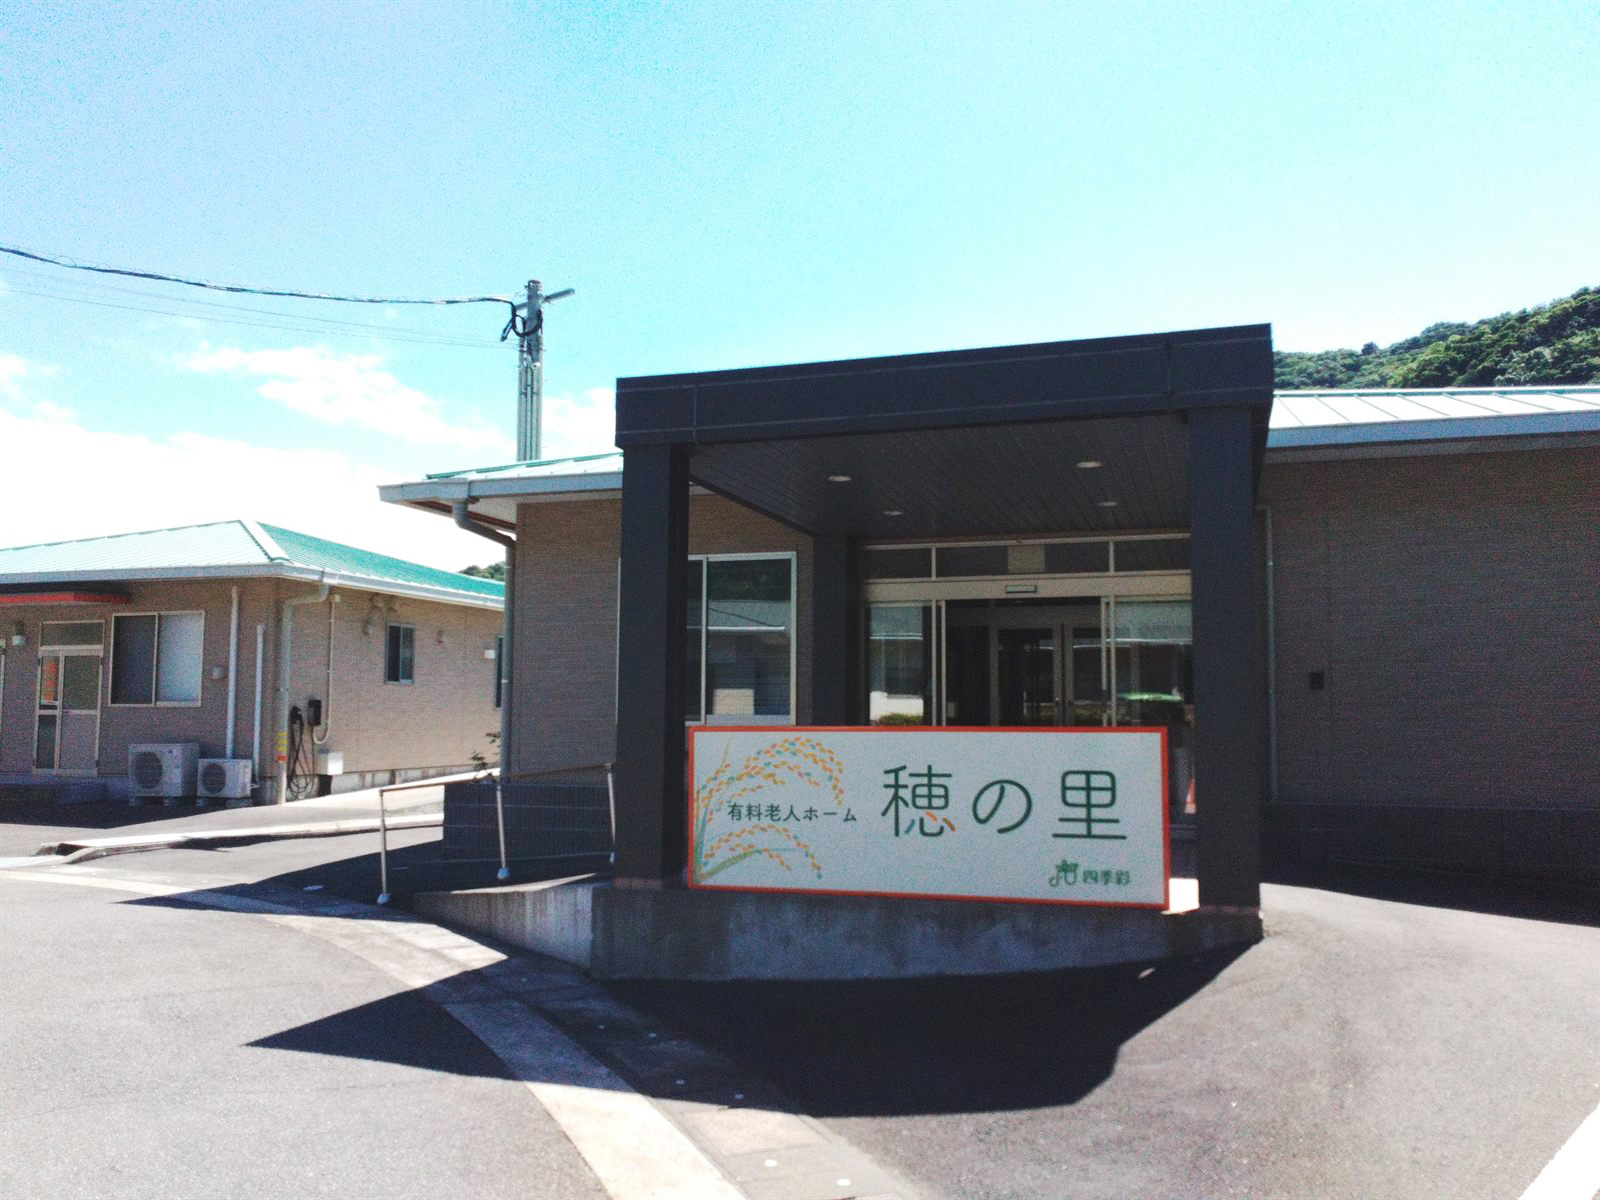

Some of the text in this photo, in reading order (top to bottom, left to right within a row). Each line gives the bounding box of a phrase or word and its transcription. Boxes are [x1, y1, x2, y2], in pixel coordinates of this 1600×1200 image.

[727, 801, 858, 823] 有料老人ホーム
[881, 764, 1127, 840] 穂の里
